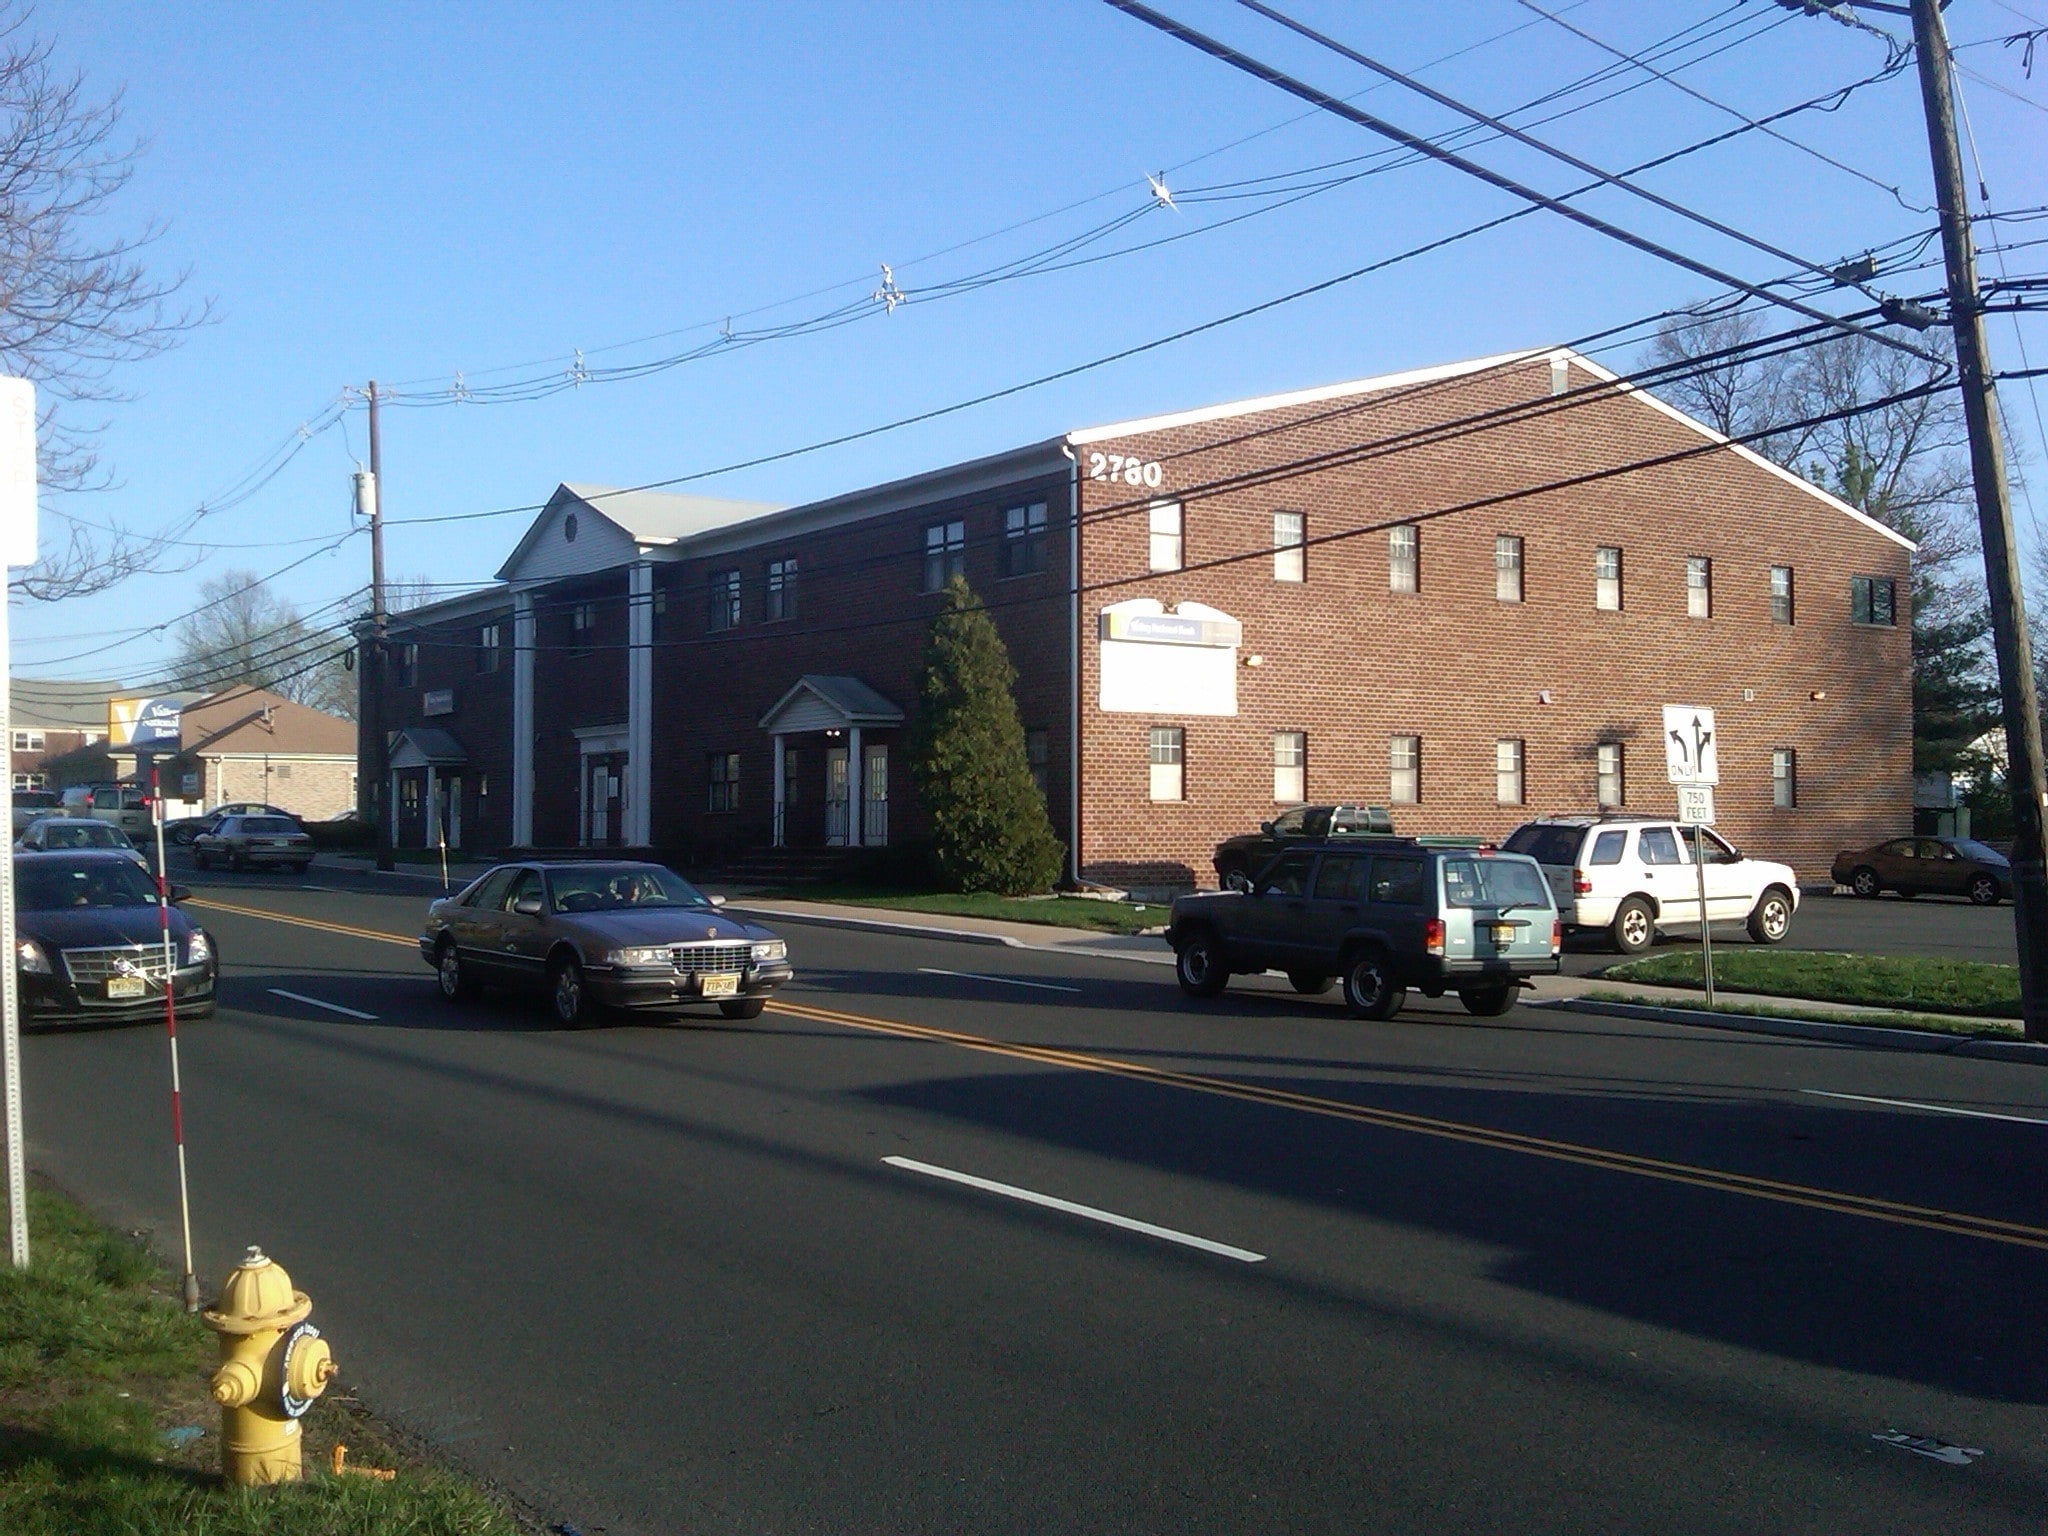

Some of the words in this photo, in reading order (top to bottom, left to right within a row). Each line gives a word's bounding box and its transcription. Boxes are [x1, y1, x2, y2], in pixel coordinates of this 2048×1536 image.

[1671, 764, 1695, 777] ONLY
[1687, 791, 1705, 804] 750
[1686, 806, 1707, 819] FEET
